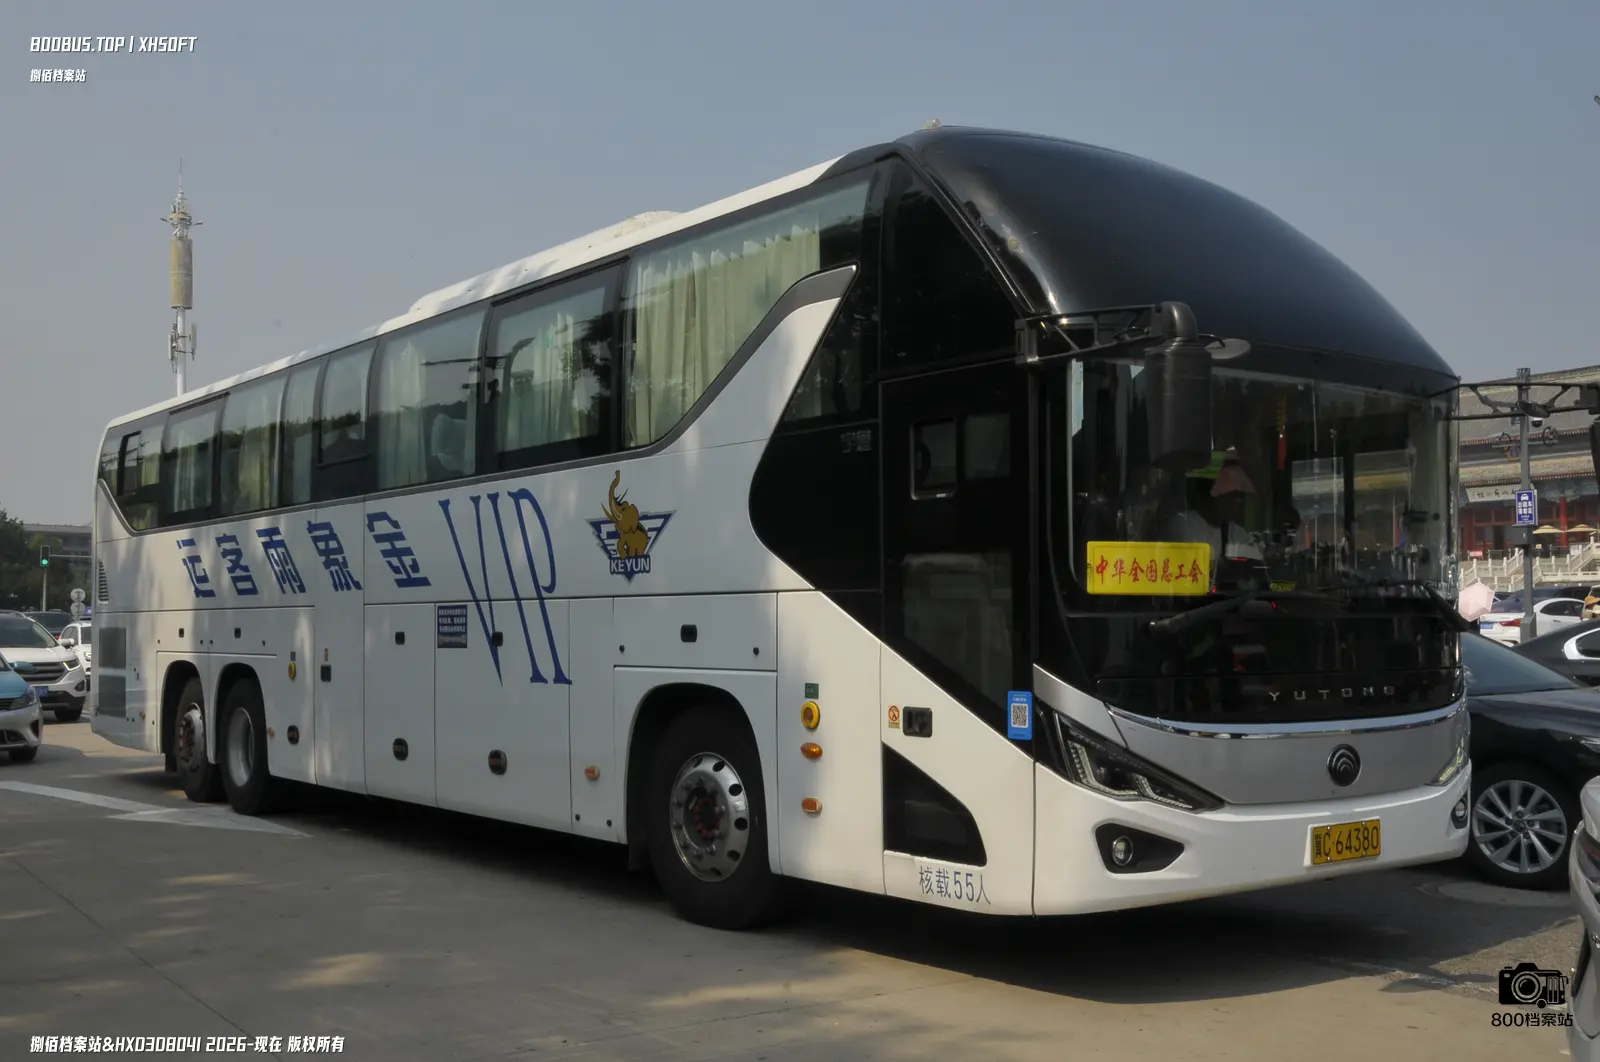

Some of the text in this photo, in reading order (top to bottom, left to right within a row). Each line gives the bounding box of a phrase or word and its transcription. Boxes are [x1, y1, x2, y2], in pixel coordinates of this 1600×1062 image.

[610, 556, 650, 574] KEYUN
[438, 487, 573, 689] VIP
[1268, 686, 1395, 701] YUTONG
[919, 865, 992, 906] 核载55人
